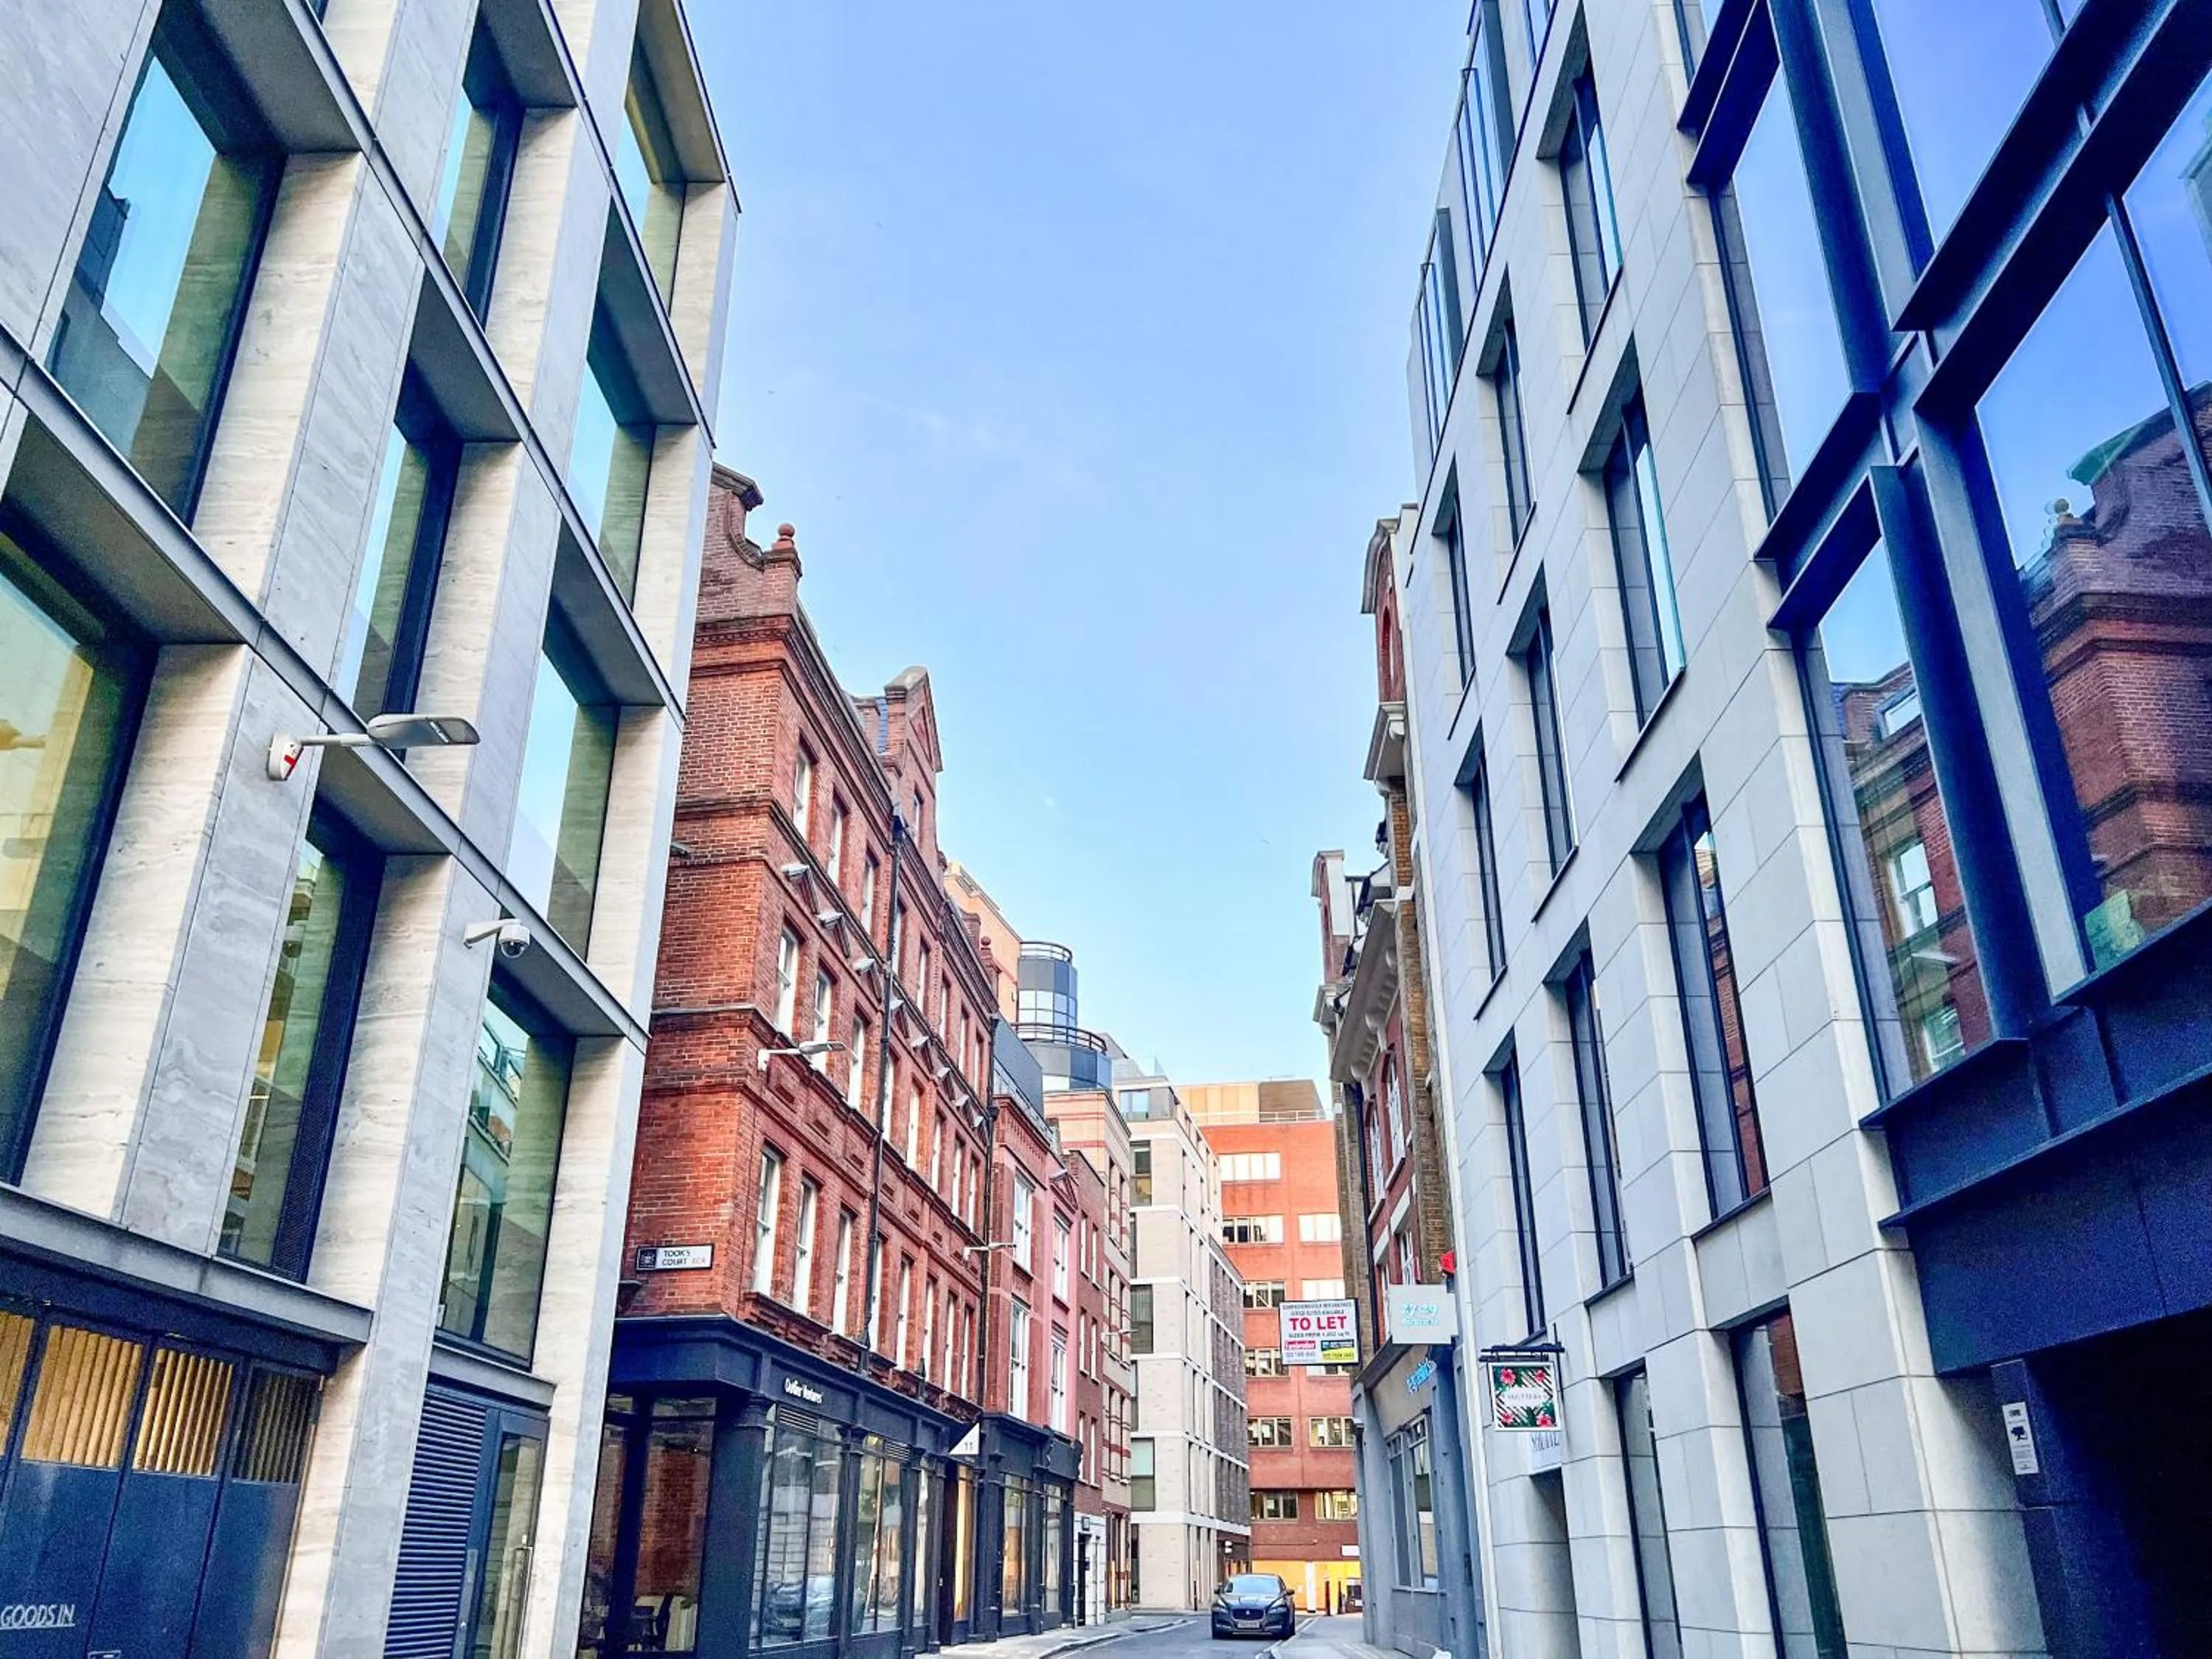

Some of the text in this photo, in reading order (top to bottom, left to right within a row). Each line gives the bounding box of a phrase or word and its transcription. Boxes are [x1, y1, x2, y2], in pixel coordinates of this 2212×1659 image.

[664, 1249, 691, 1257] TOOK'S
[661, 1257, 688, 1266] COURT
[1289, 1315, 1347, 1331] TO LET
[1, 1604, 75, 1627] GOODS IN
